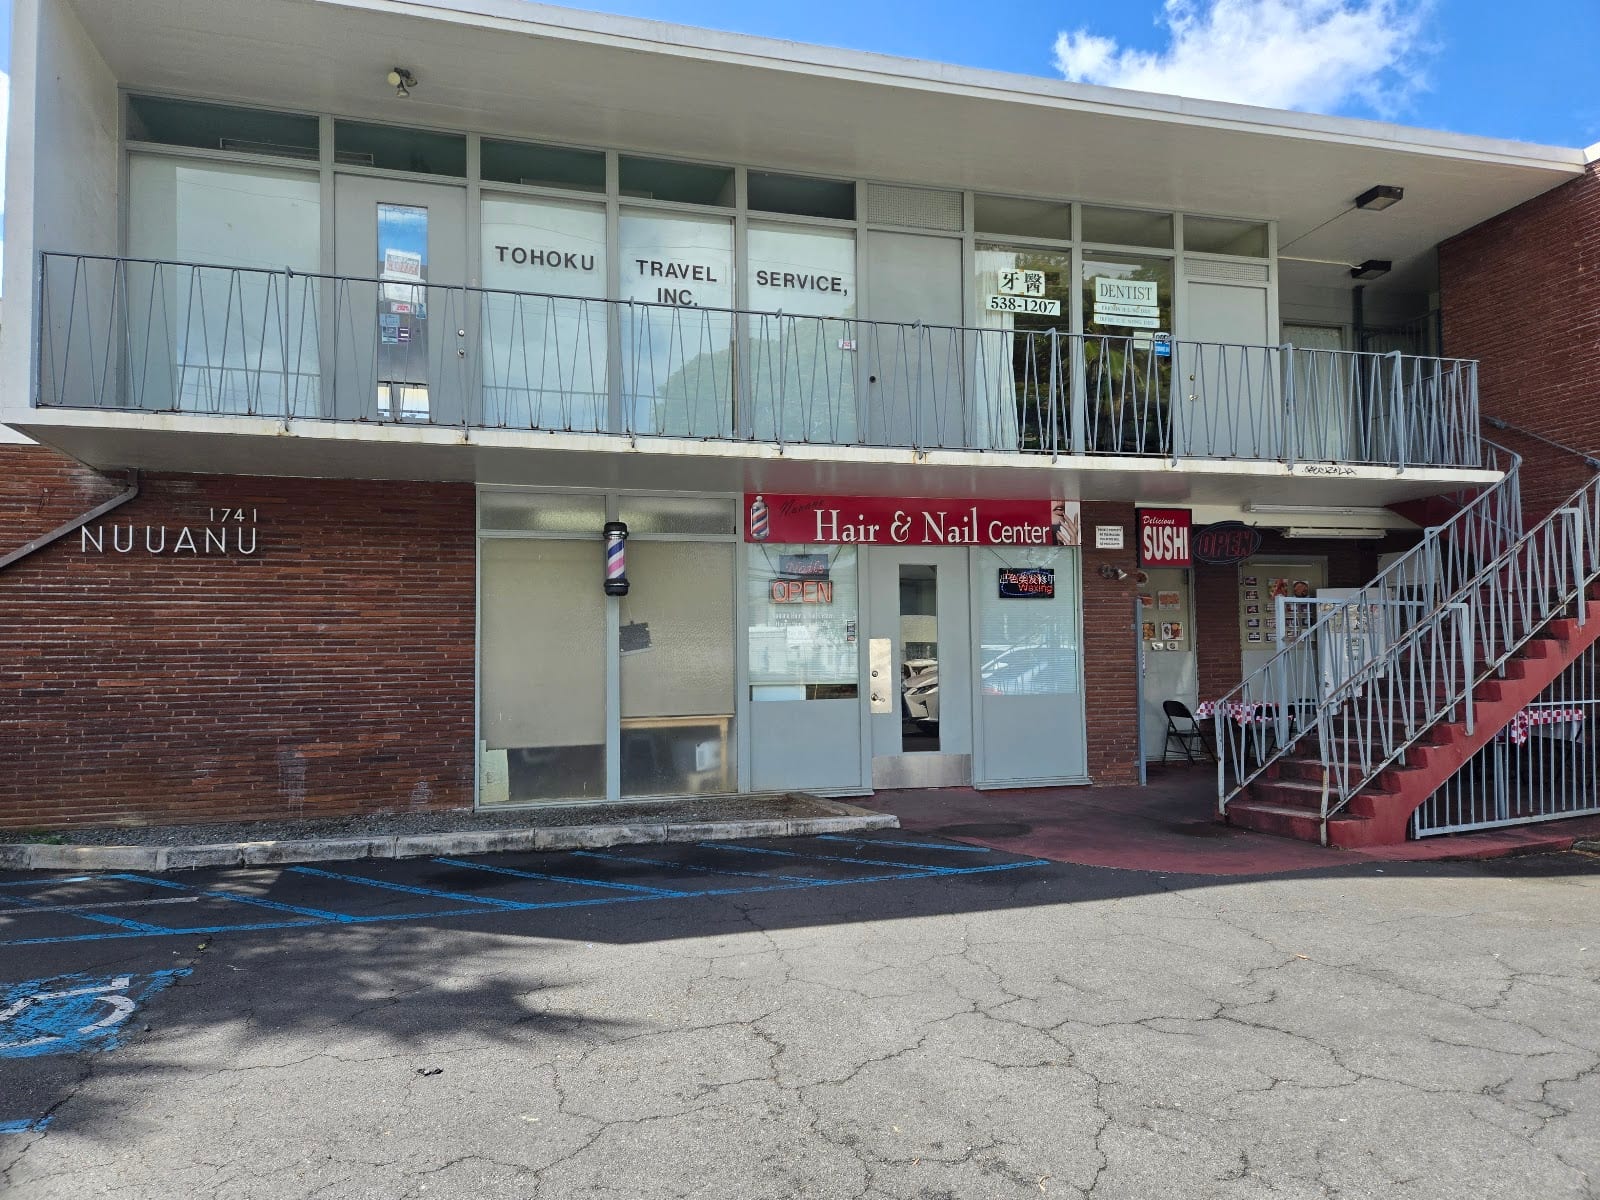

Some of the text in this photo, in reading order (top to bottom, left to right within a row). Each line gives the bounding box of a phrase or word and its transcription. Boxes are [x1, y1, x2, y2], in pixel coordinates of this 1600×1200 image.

[495, 245, 848, 296] TOHOKU TRAVEL SERVICE,
[1001, 271, 1042, 294] 牙醫
[1100, 283, 1152, 301] DENTIST
[657, 287, 698, 307] INC.
[991, 296, 1056, 314] 538-1207
[210, 507, 257, 523] 1741
[813, 506, 1050, 544] Hair & Nail Center
[1142, 515, 1175, 525] Delicious
[81, 524, 257, 554] NUUANU
[1143, 525, 1189, 561] SUSHI
[771, 580, 833, 603] OPEN
